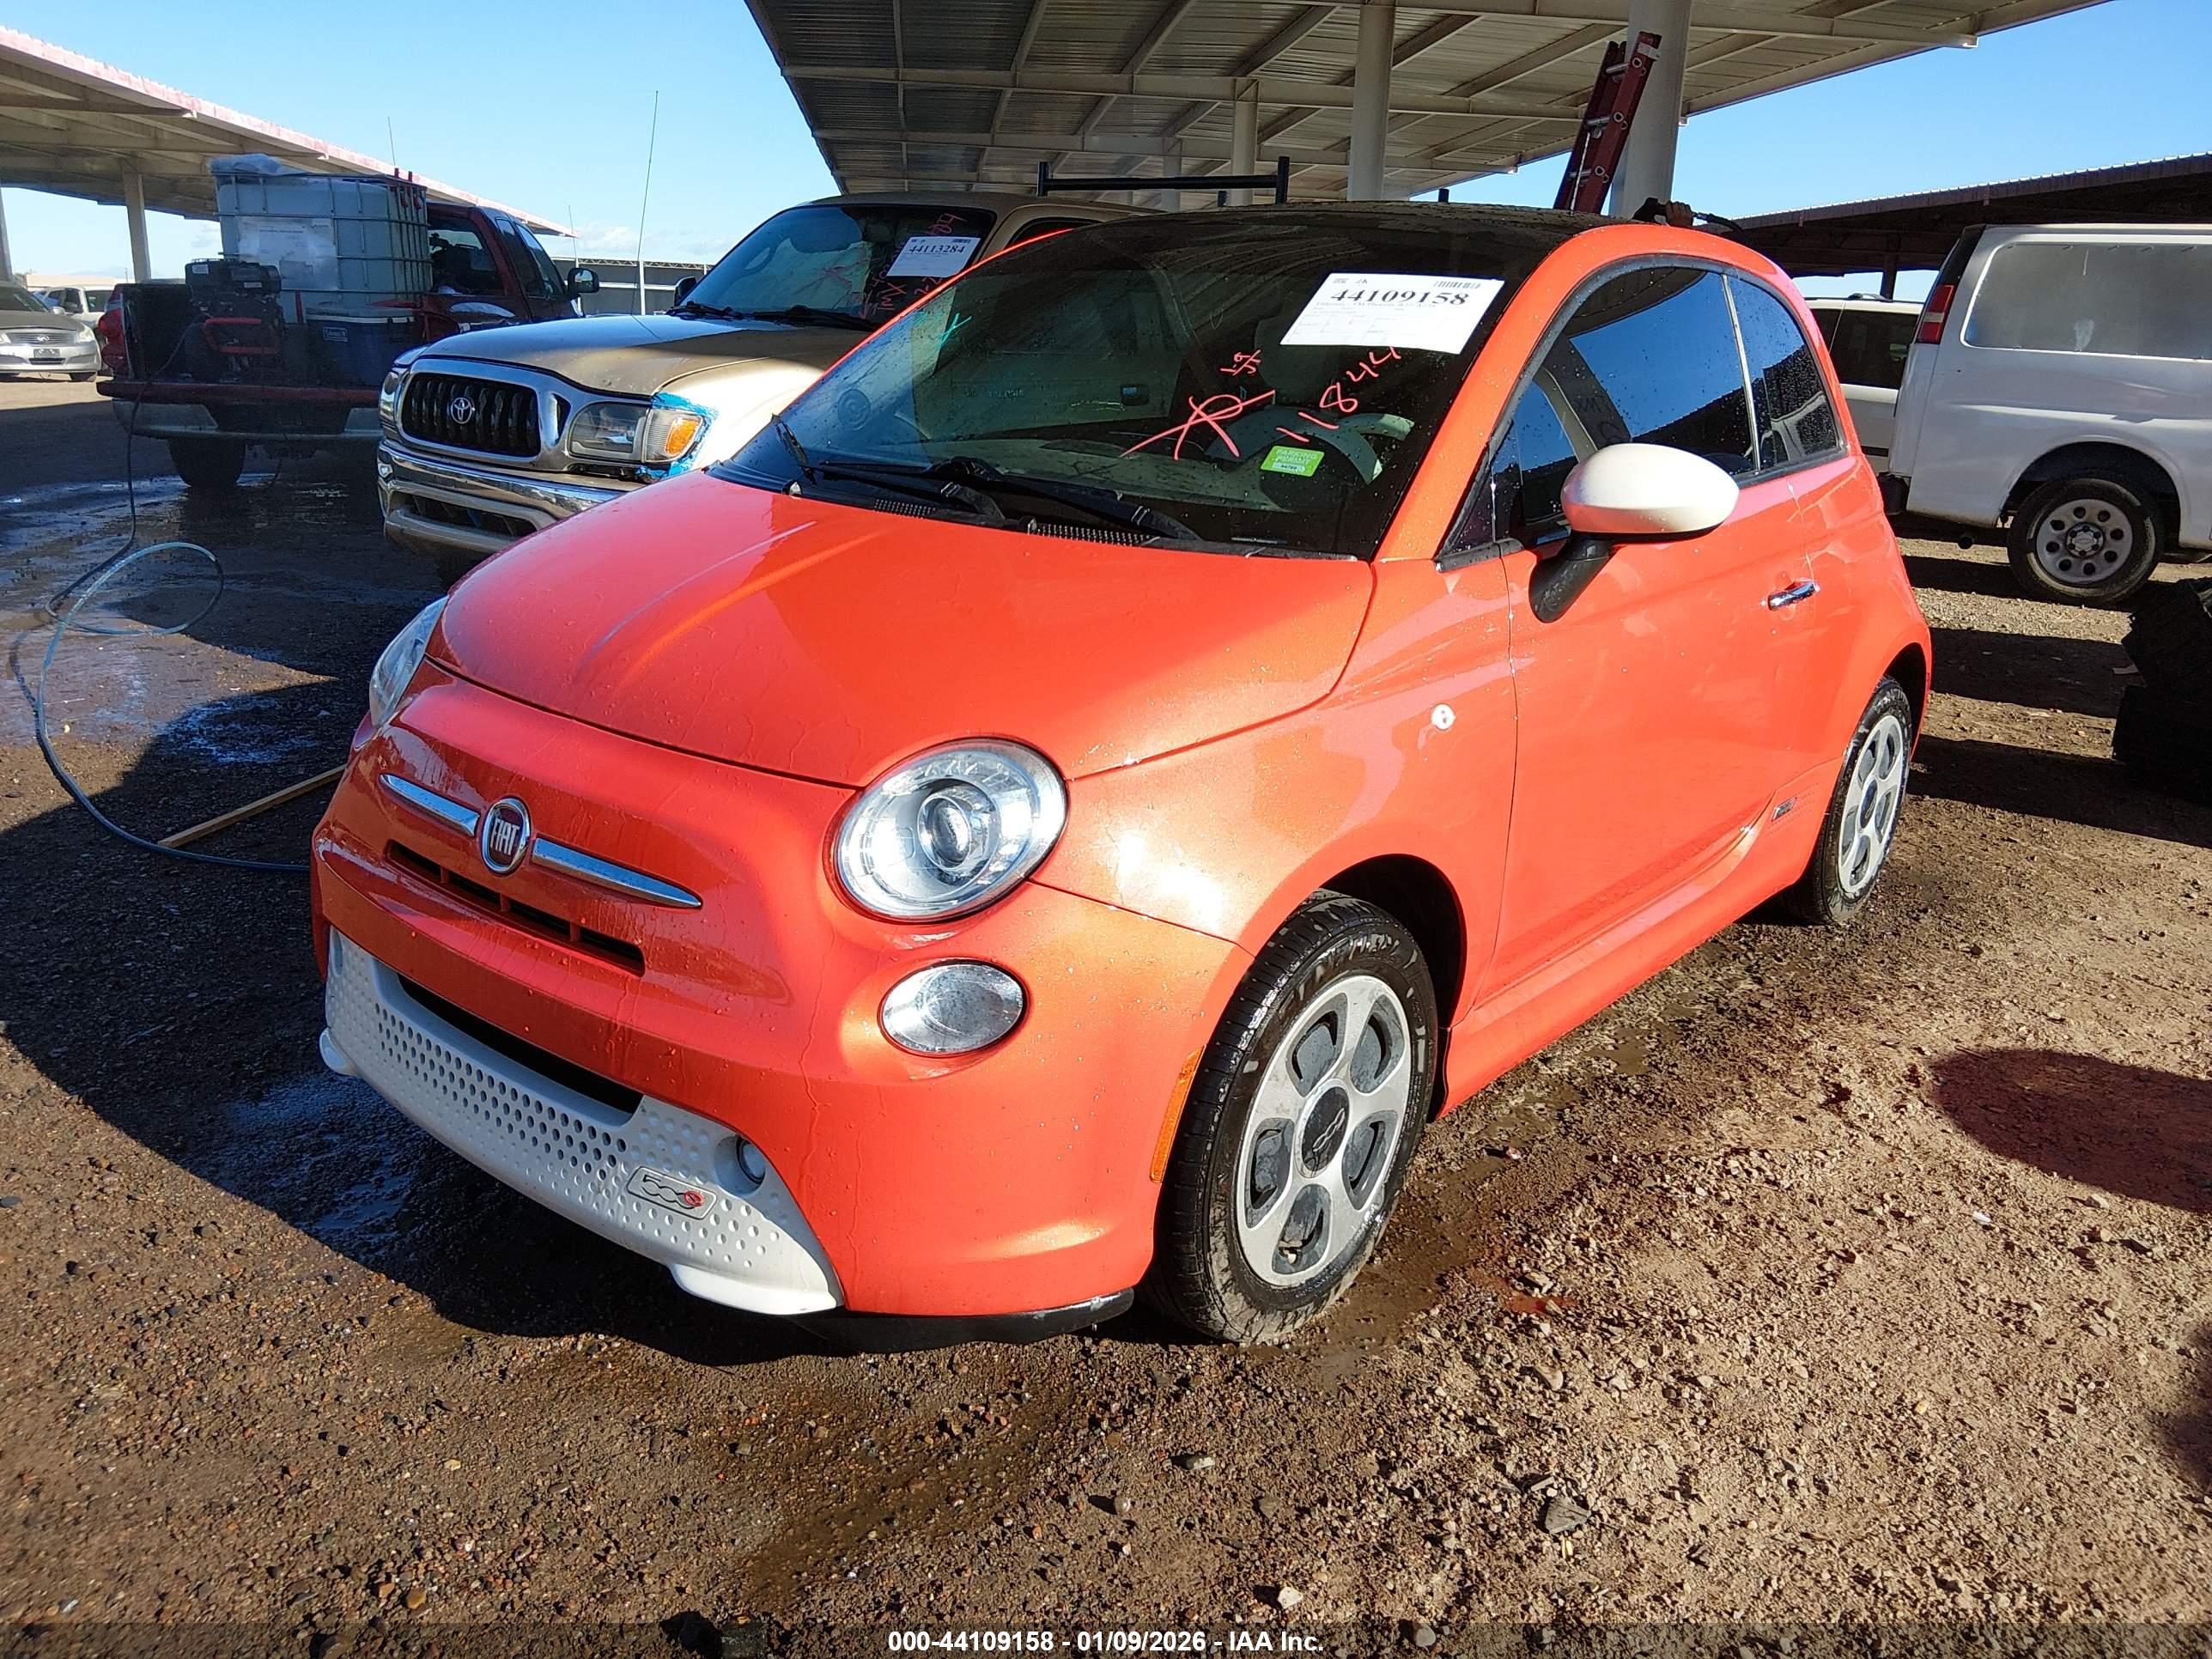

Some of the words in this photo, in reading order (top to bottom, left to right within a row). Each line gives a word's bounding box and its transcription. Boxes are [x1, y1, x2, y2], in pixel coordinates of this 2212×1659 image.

[908, 245, 966, 254] 44113284
[1330, 289, 1470, 306] 44109158
[489, 818, 520, 856] FIAT
